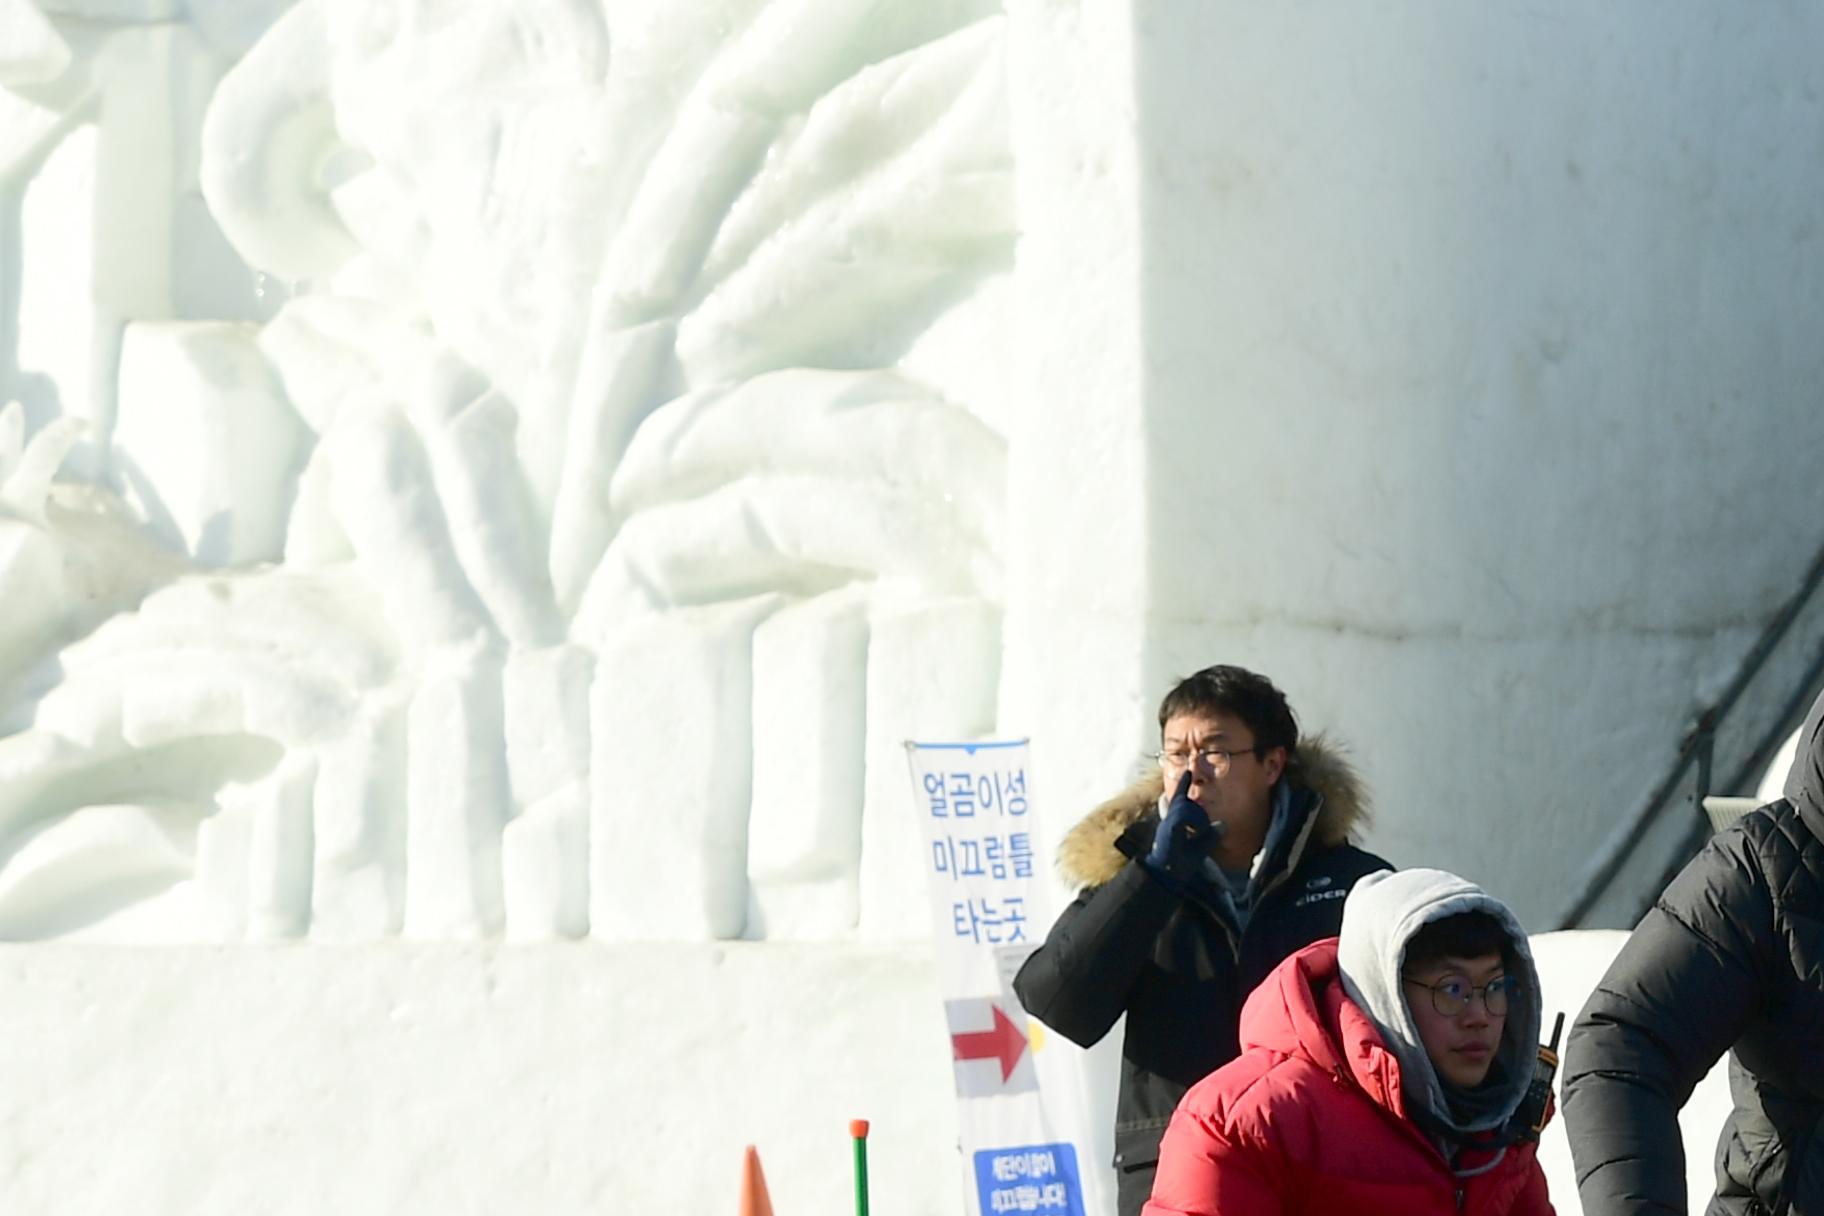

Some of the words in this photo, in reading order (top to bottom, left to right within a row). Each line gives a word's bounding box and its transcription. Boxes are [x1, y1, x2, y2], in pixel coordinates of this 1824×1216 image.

[923, 768, 1028, 819] 얼곰이성
[932, 832, 1034, 881] 미끄럼틀
[953, 897, 1027, 944] 타는곳
